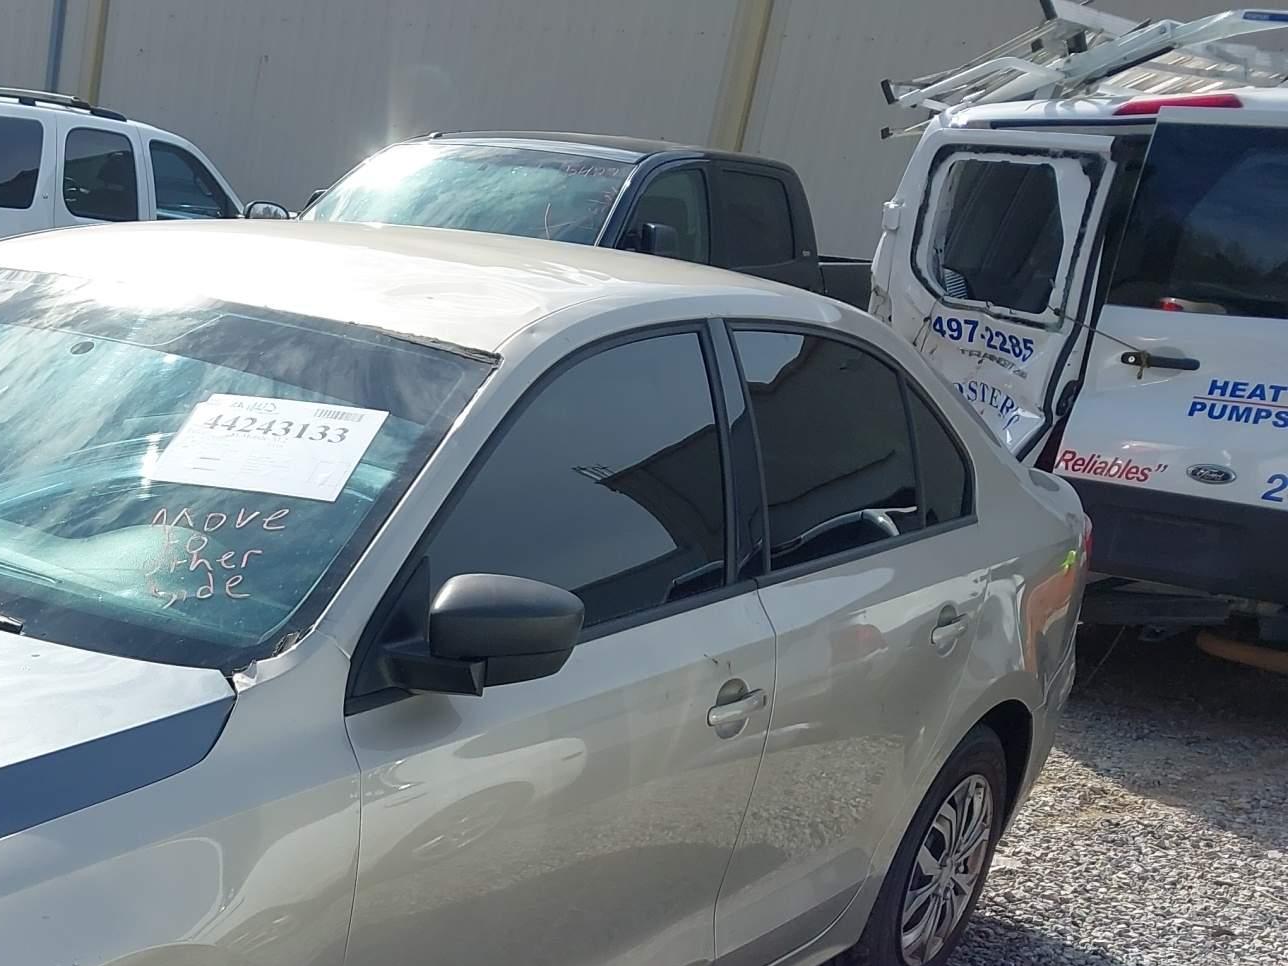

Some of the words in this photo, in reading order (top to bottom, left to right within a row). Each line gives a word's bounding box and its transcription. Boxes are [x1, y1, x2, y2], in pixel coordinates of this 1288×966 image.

[932, 316, 1034, 362] 497-2285
[1207, 379, 1288, 402] HEAT
[204, 413, 350, 444] 44243133
[1187, 401, 1288, 428] PUMPS
